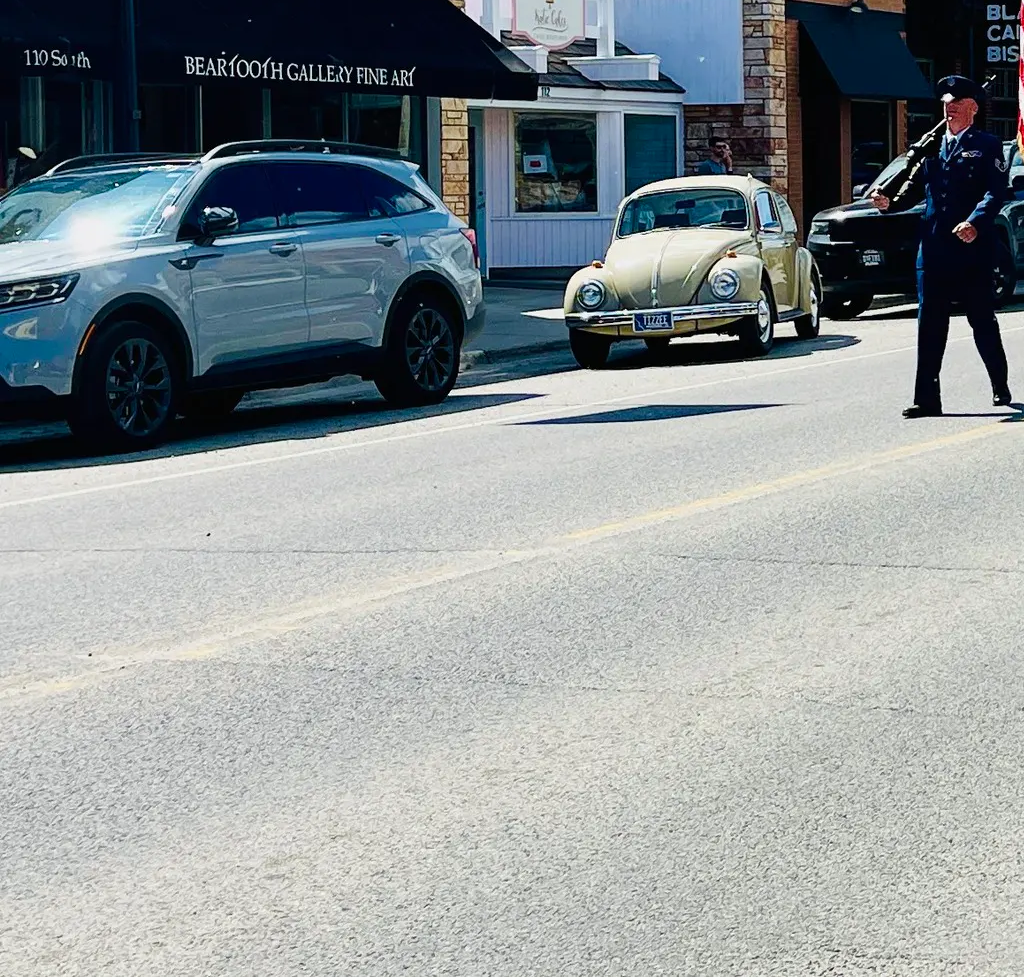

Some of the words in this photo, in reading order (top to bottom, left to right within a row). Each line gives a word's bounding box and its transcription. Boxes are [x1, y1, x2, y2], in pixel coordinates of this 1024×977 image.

[986, 4, 1021, 21] BL
[24, 49, 48, 66] 110
[184, 53, 284, 80] BEARTOOTH
[286, 62, 353, 83] GALLERY
[356, 67, 388, 85] FINE
[390, 66, 416, 87] ART
